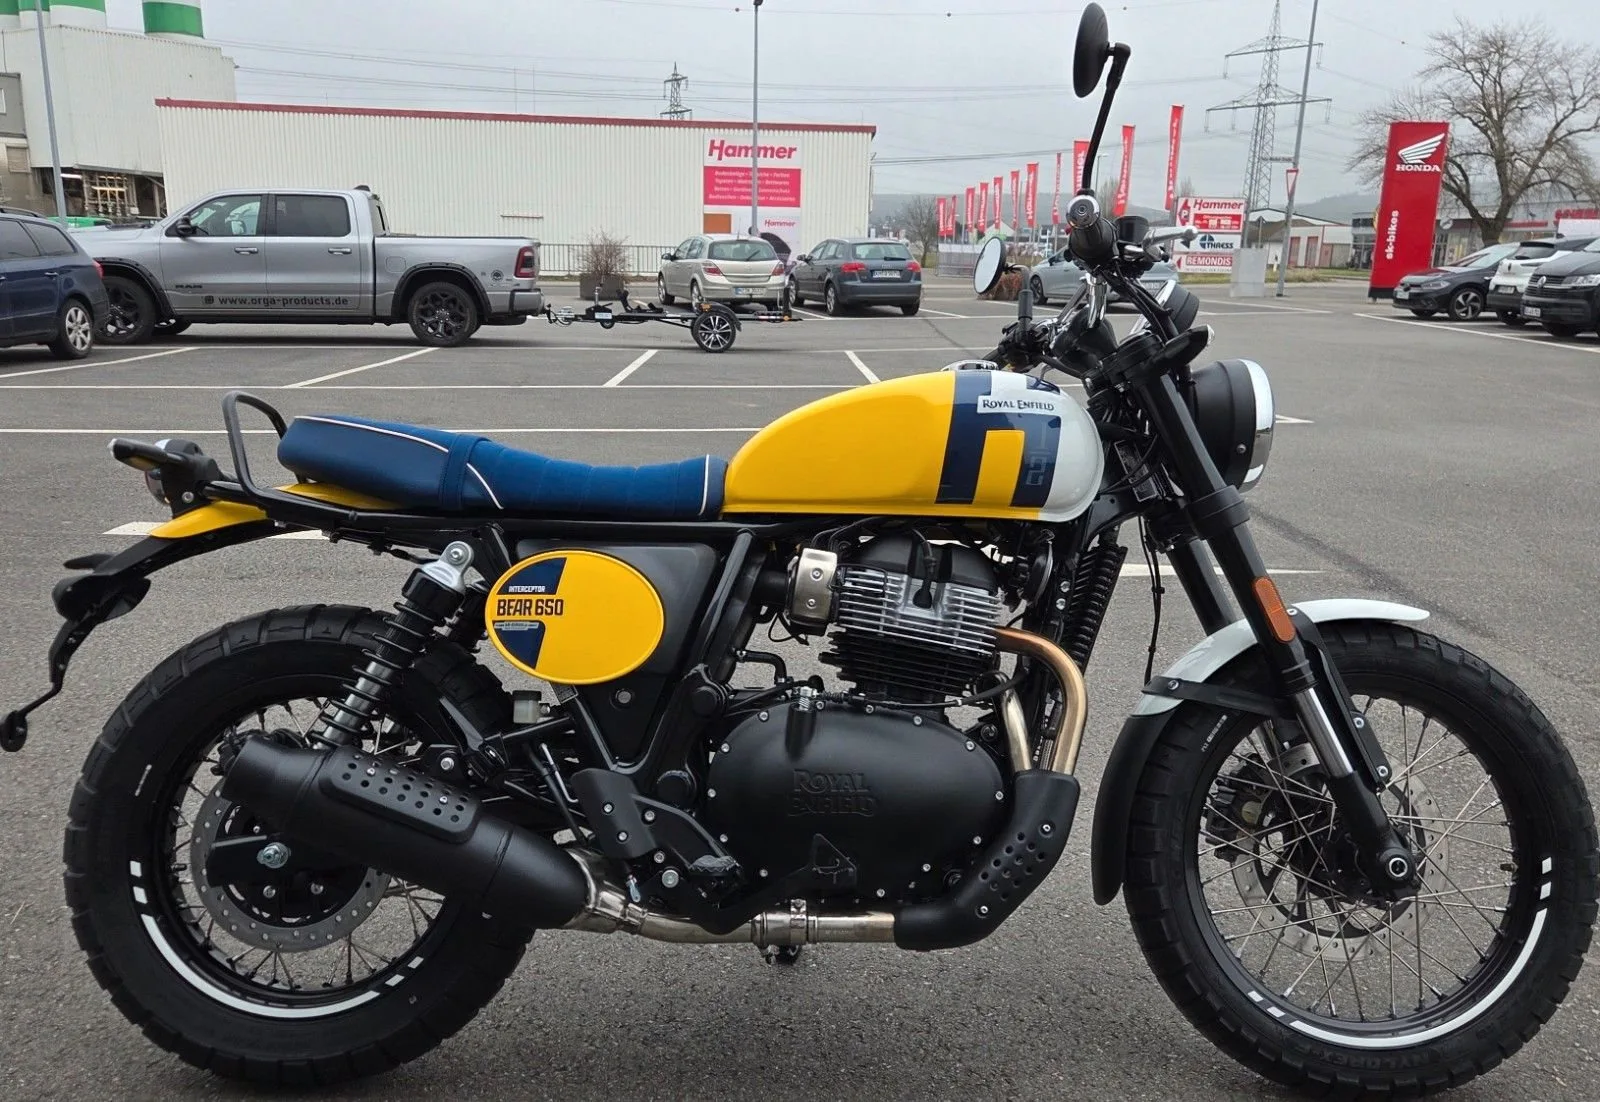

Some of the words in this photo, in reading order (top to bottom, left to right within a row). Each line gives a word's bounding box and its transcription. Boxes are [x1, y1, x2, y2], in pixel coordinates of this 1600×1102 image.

[708, 140, 797, 161] Hammer
[1395, 163, 1442, 172] HONDA
[1193, 198, 1244, 211] Hammer
[764, 219, 796, 228] Hammer
[1385, 209, 1399, 260] sk-bikes
[1187, 256, 1232, 266] REMONDIS
[218, 296, 348, 307] www.orga-products.de
[982, 399, 1016, 409] ROYAL
[1016, 400, 1055, 411] ENFIELD
[508, 585, 546, 593] INTERCEPTOR
[496, 598, 533, 616] BEAR
[534, 598, 564, 616] 650
[793, 768, 869, 793] ROYAL
